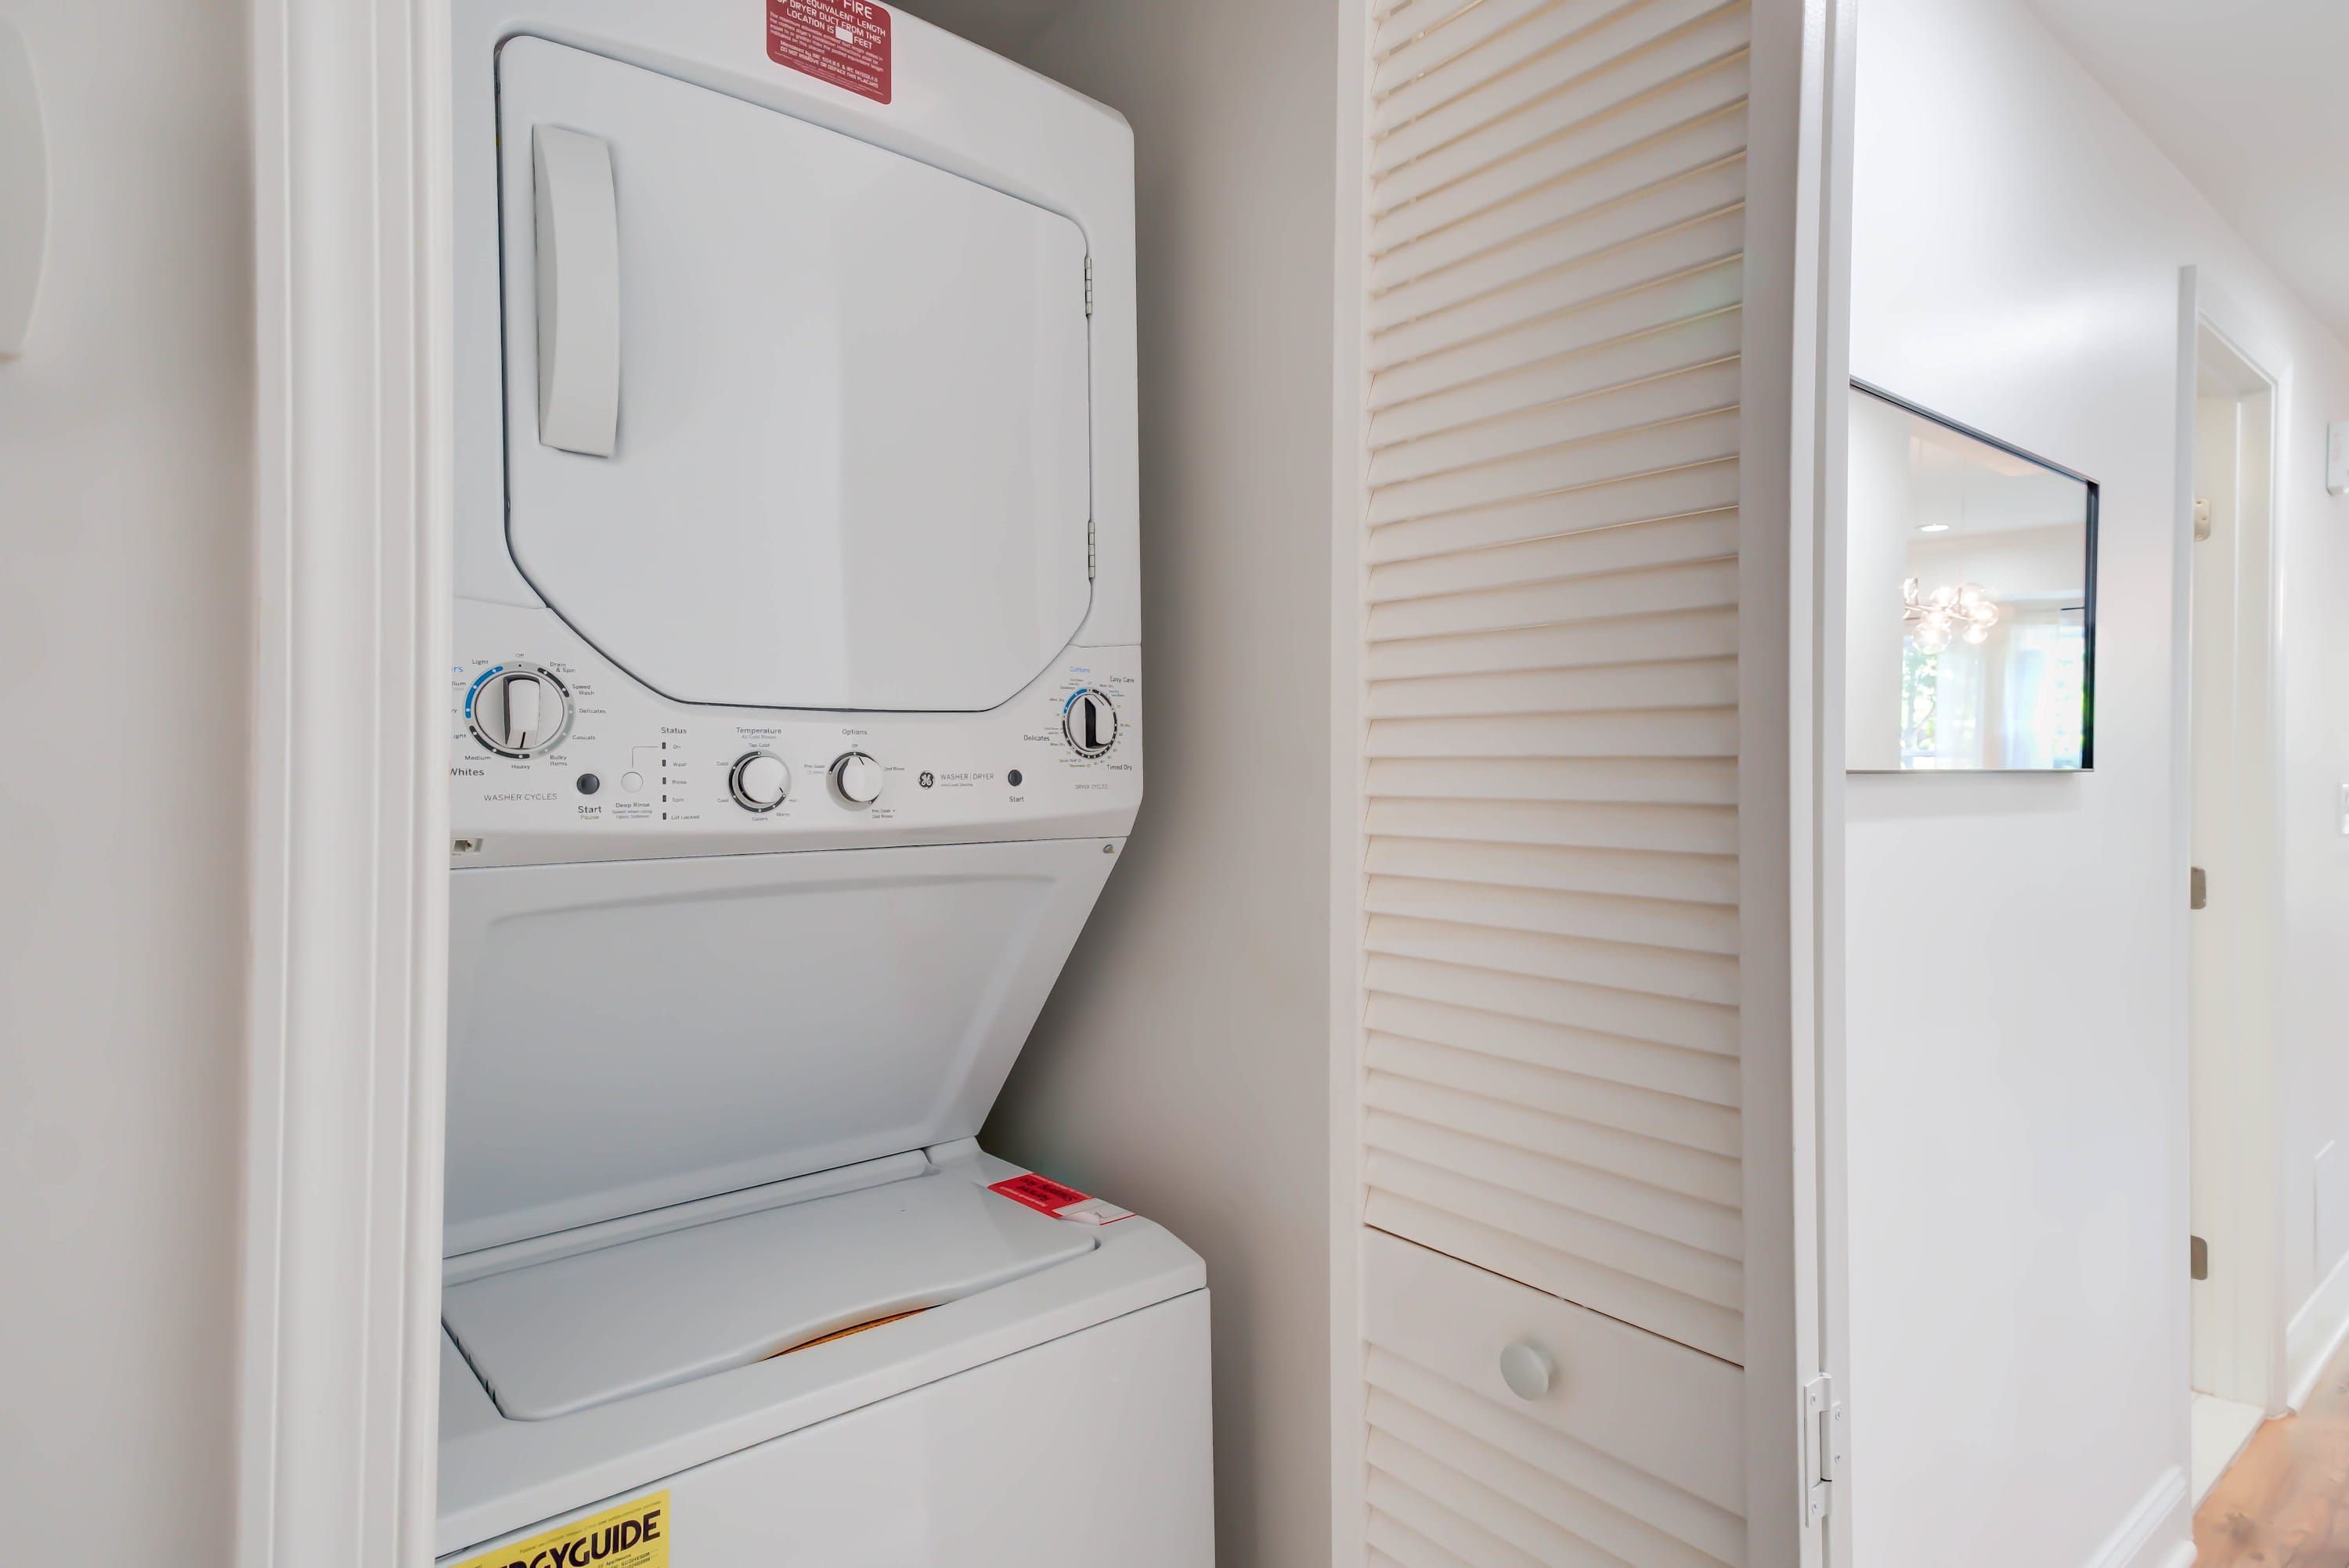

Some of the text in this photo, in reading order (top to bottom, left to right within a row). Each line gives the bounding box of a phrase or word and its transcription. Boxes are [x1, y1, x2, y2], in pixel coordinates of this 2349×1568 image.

[790, 0, 882, 45] DRYER DUCT FROM THIS
[806, 0, 886, 37] EQUIVALENT LENGTH
[843, 0, 872, 20] FIRE
[786, 7, 872, 49] LOCATION IS FEET
[857, 75, 879, 88] PLACARD
[736, 726, 781, 735] Temperature
